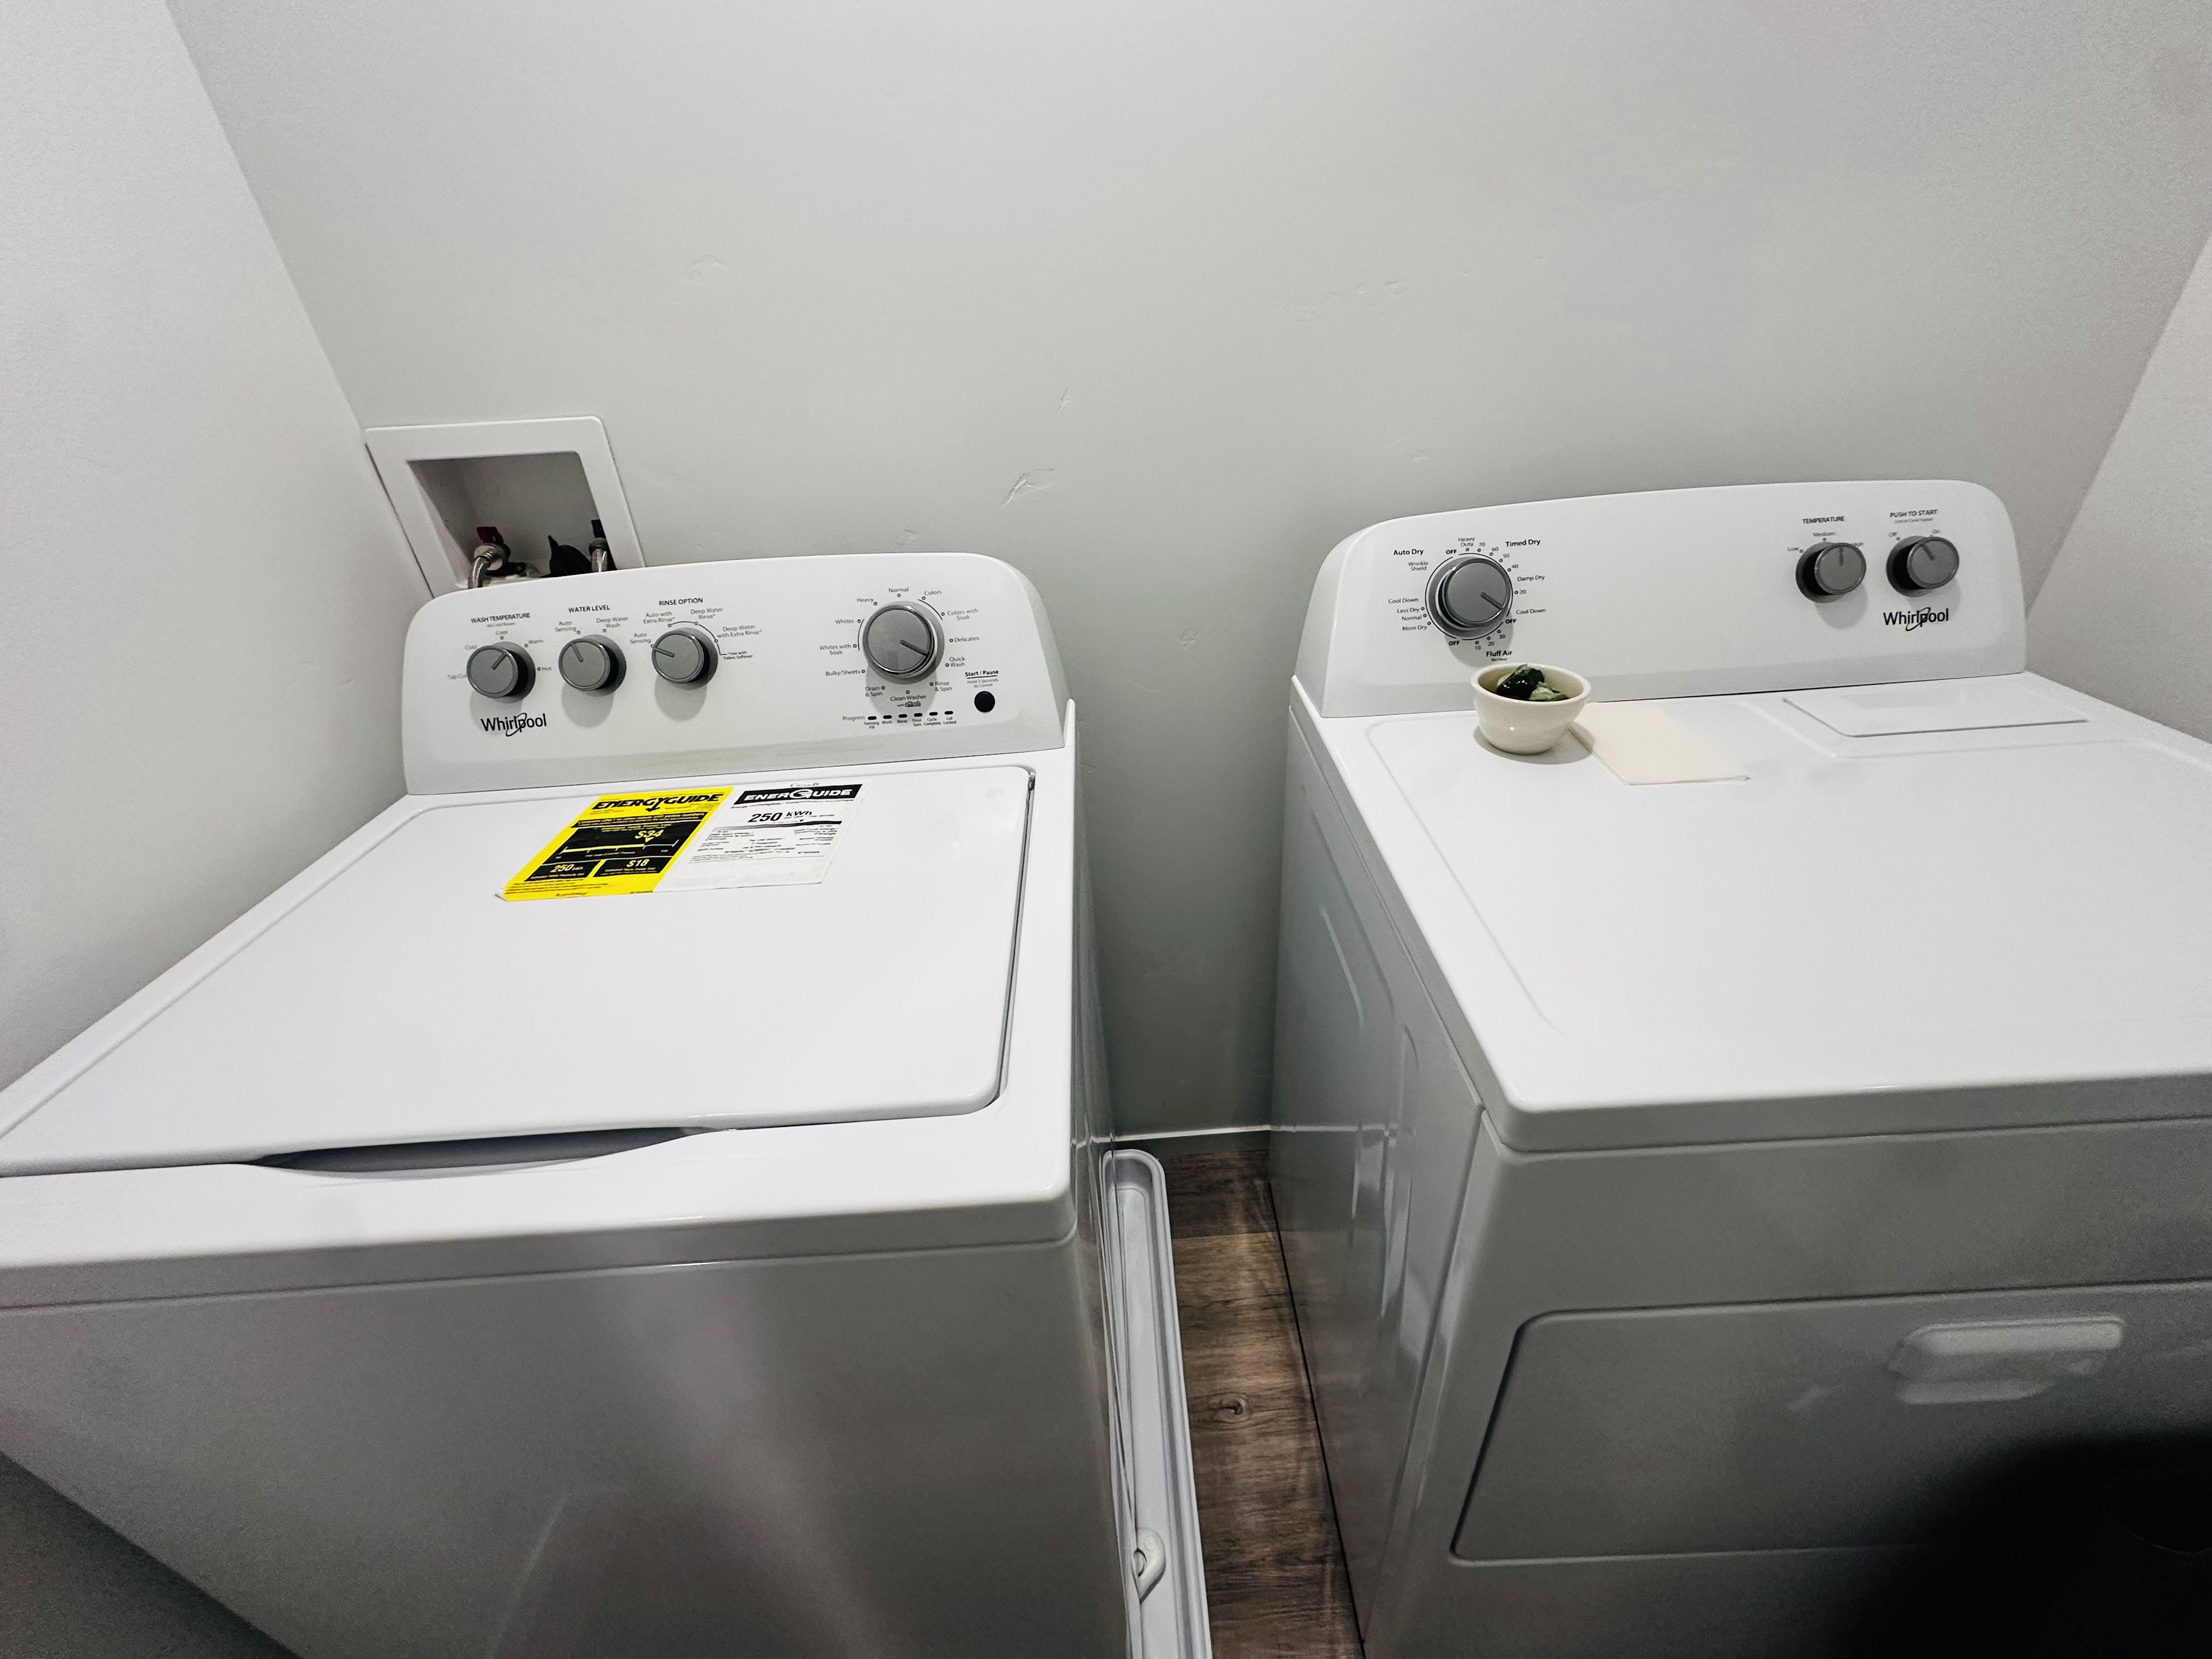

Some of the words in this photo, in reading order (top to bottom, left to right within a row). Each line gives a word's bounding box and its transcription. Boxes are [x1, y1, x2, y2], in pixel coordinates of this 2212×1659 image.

[1802, 516, 1845, 524] TEMPERATURE
[490, 613, 531, 621] TEMPERATURE
[1883, 607, 1949, 631] Whirlpool
[480, 712, 547, 737] Whirlpool
[743, 788, 853, 801] ENERGUIDE
[592, 794, 724, 811] ENERGYGUIDE
[748, 812, 783, 823] 250
[635, 830, 664, 839] $34
[550, 864, 574, 873] 250
[626, 859, 649, 868] $18
